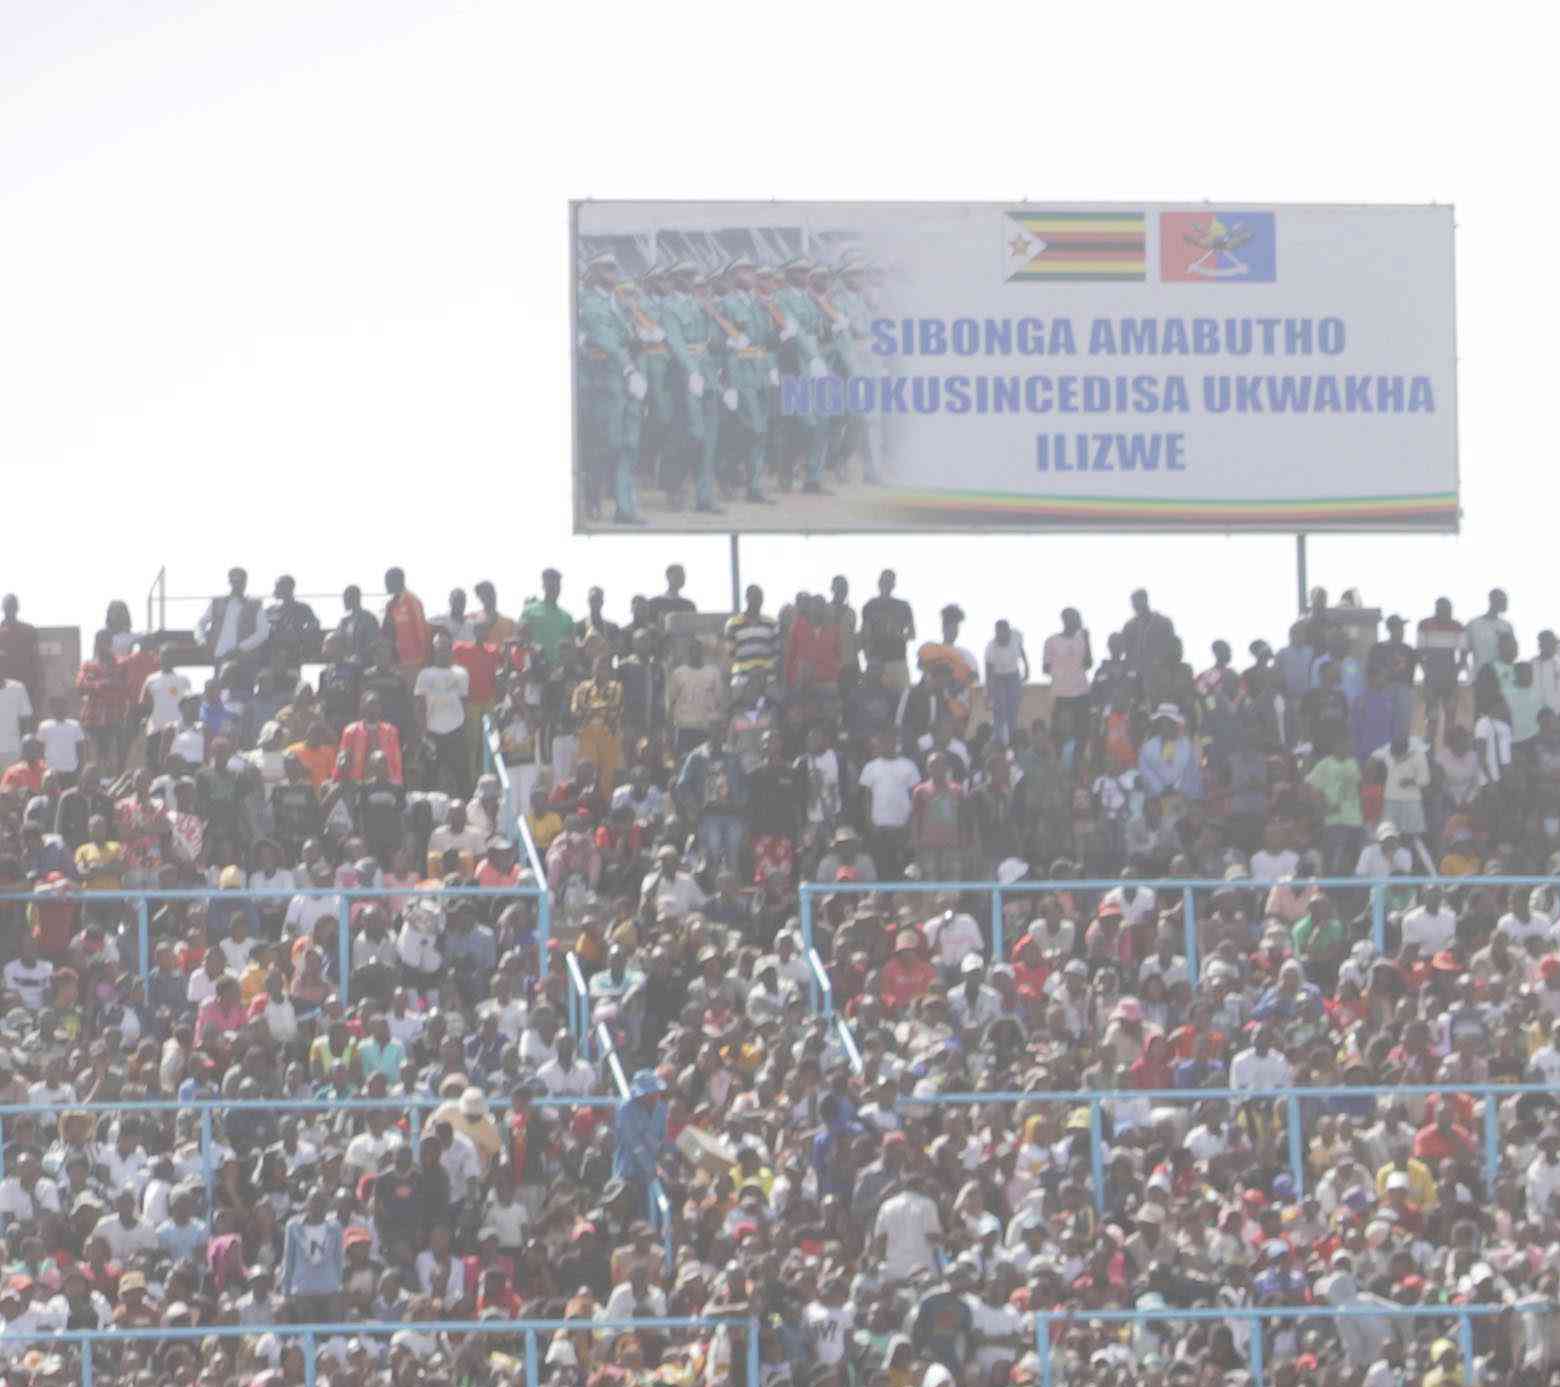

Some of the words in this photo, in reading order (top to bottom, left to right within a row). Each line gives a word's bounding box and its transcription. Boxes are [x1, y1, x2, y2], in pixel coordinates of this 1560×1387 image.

[871, 316, 1077, 357] SIBONGA
[1088, 317, 1347, 357] AMABUTHO
[781, 373, 1191, 415] NGOKUSINCEDISA
[1204, 374, 1436, 415] UKWAKHA
[1036, 432, 1187, 472] ILIZWE
